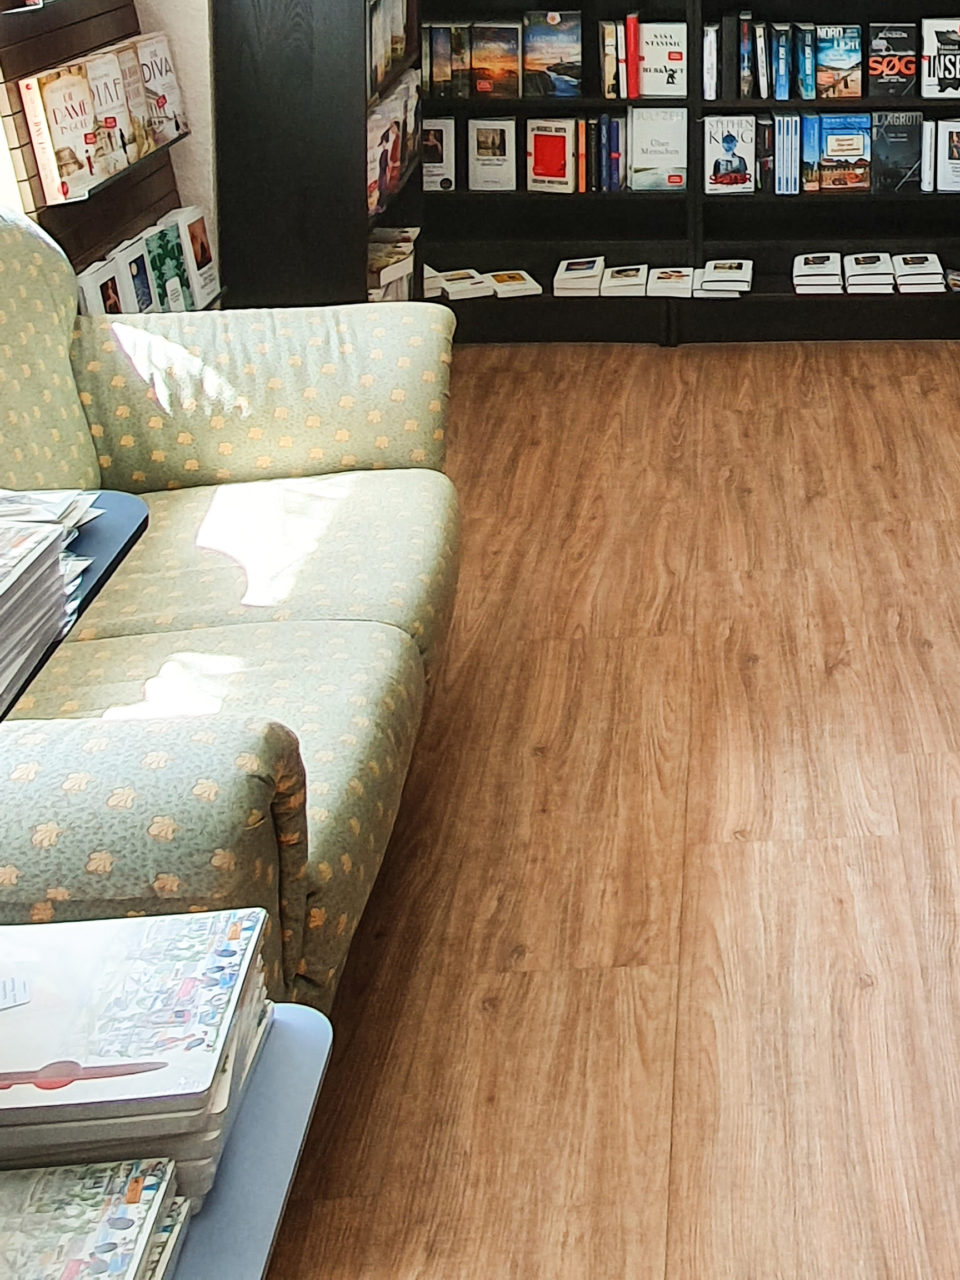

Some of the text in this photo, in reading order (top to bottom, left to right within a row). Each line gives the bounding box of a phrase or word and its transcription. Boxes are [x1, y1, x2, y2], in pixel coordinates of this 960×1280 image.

[817, 27, 843, 39] NORD
[834, 39, 860, 50] LICHT
[141, 57, 173, 83] DIVA
[868, 57, 916, 76] SØG
[709, 119, 753, 129] STEPHEN
